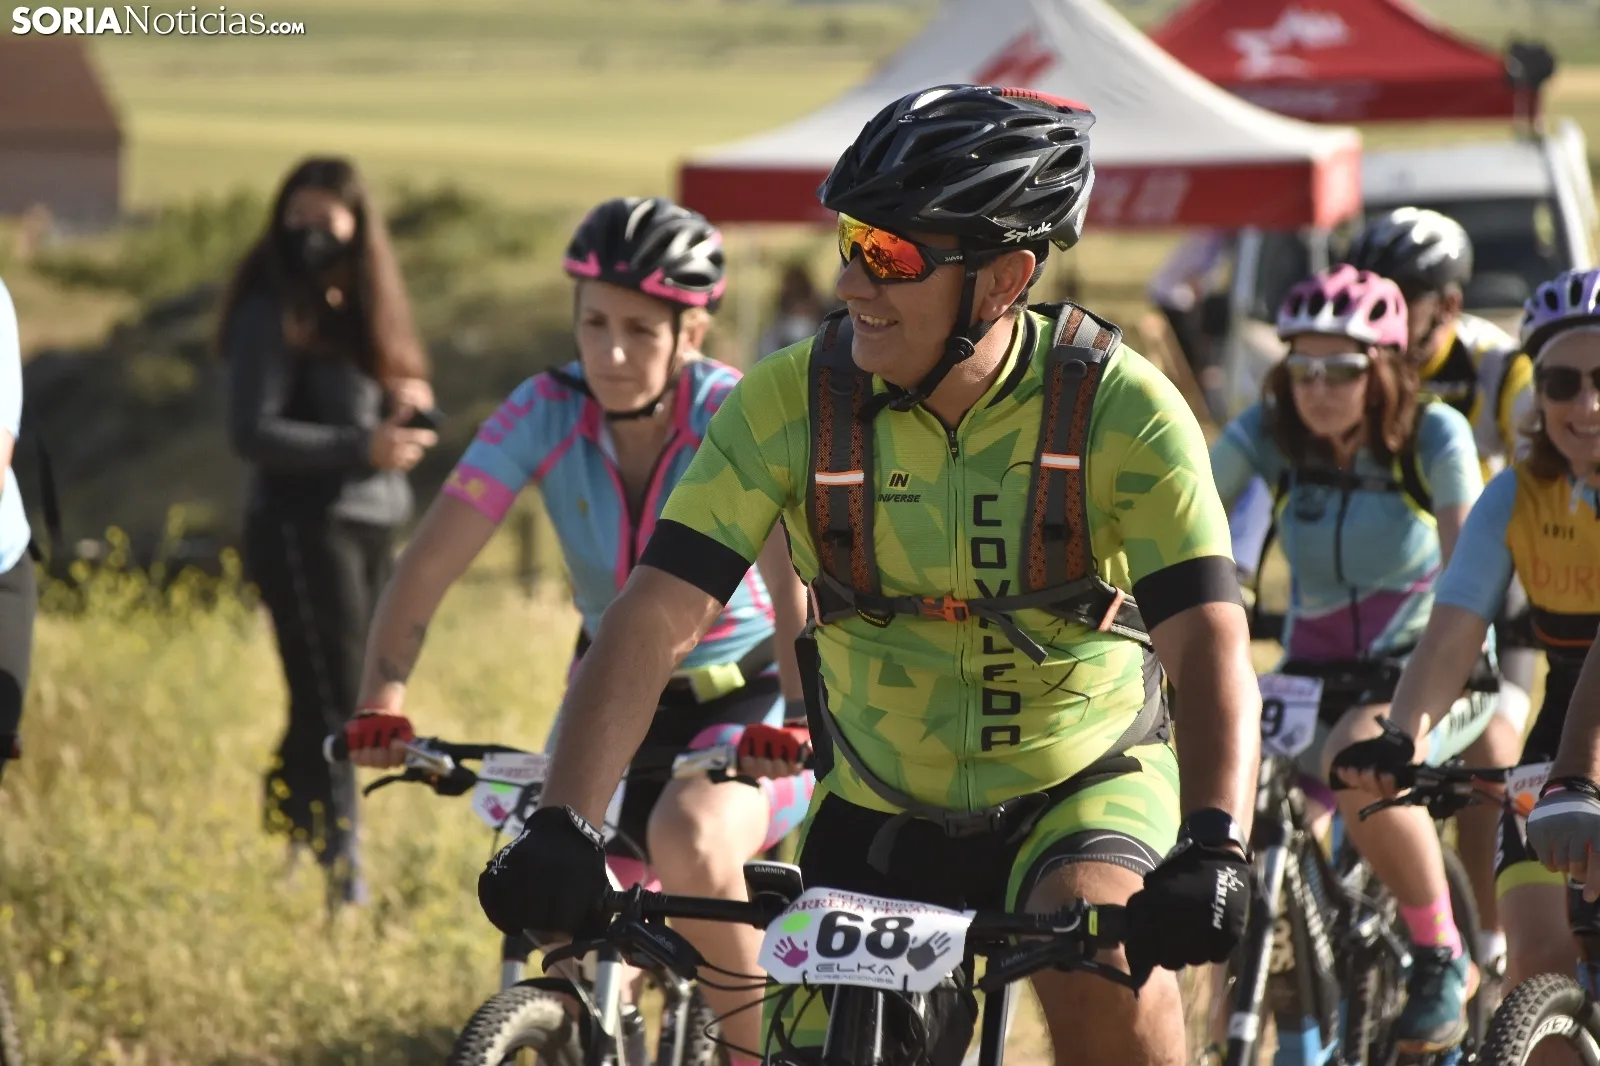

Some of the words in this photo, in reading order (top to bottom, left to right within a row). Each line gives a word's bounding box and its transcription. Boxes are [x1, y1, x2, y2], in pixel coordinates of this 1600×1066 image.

[1001, 221, 1052, 243] Spiuk
[888, 473, 910, 488] IN
[877, 493, 921, 503] INVERSE
[753, 865, 786, 876] GARMIN
[815, 910, 915, 960] 68
[815, 961, 896, 977] ELKA
